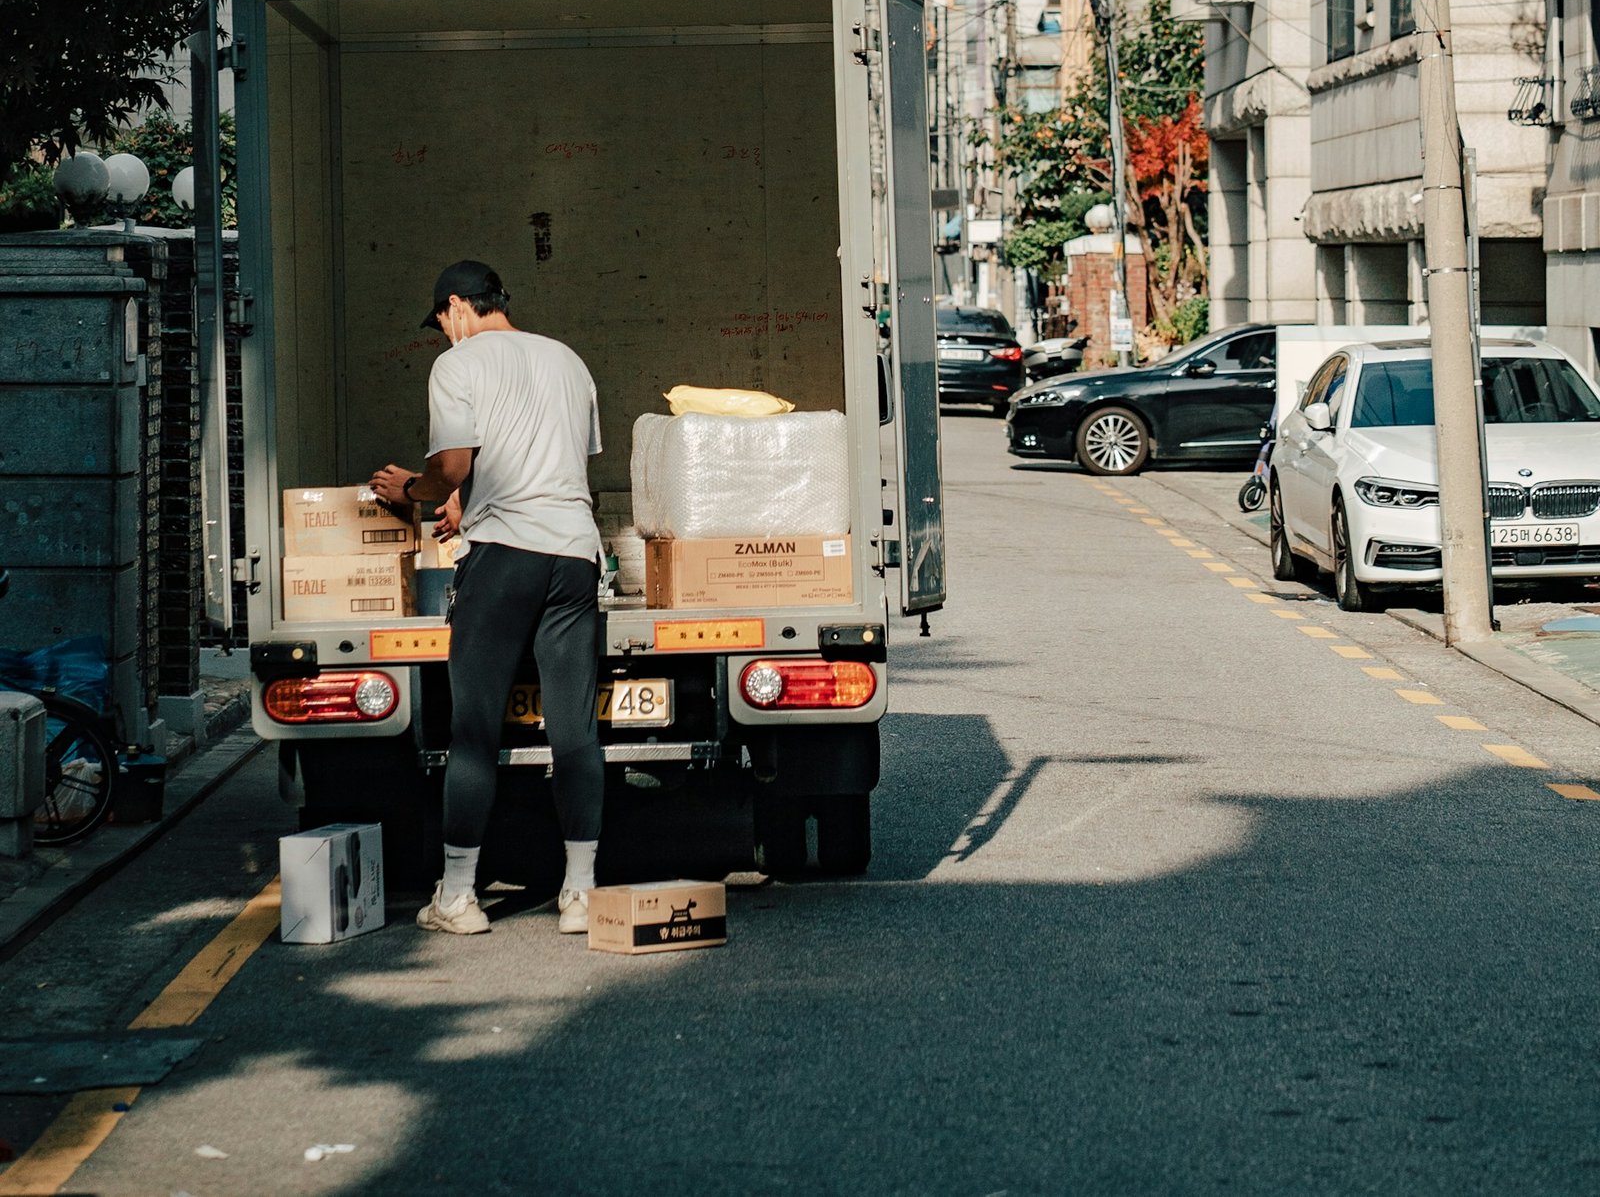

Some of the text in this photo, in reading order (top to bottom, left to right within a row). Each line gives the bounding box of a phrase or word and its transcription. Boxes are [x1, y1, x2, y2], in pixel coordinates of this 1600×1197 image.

[303, 511, 338, 528] TEAZLE
[1534, 527, 1573, 543] 6638
[735, 542, 796, 555] ZALMAN
[769, 559, 793, 569] (Bulk)
[291, 579, 327, 595] TEAZLE
